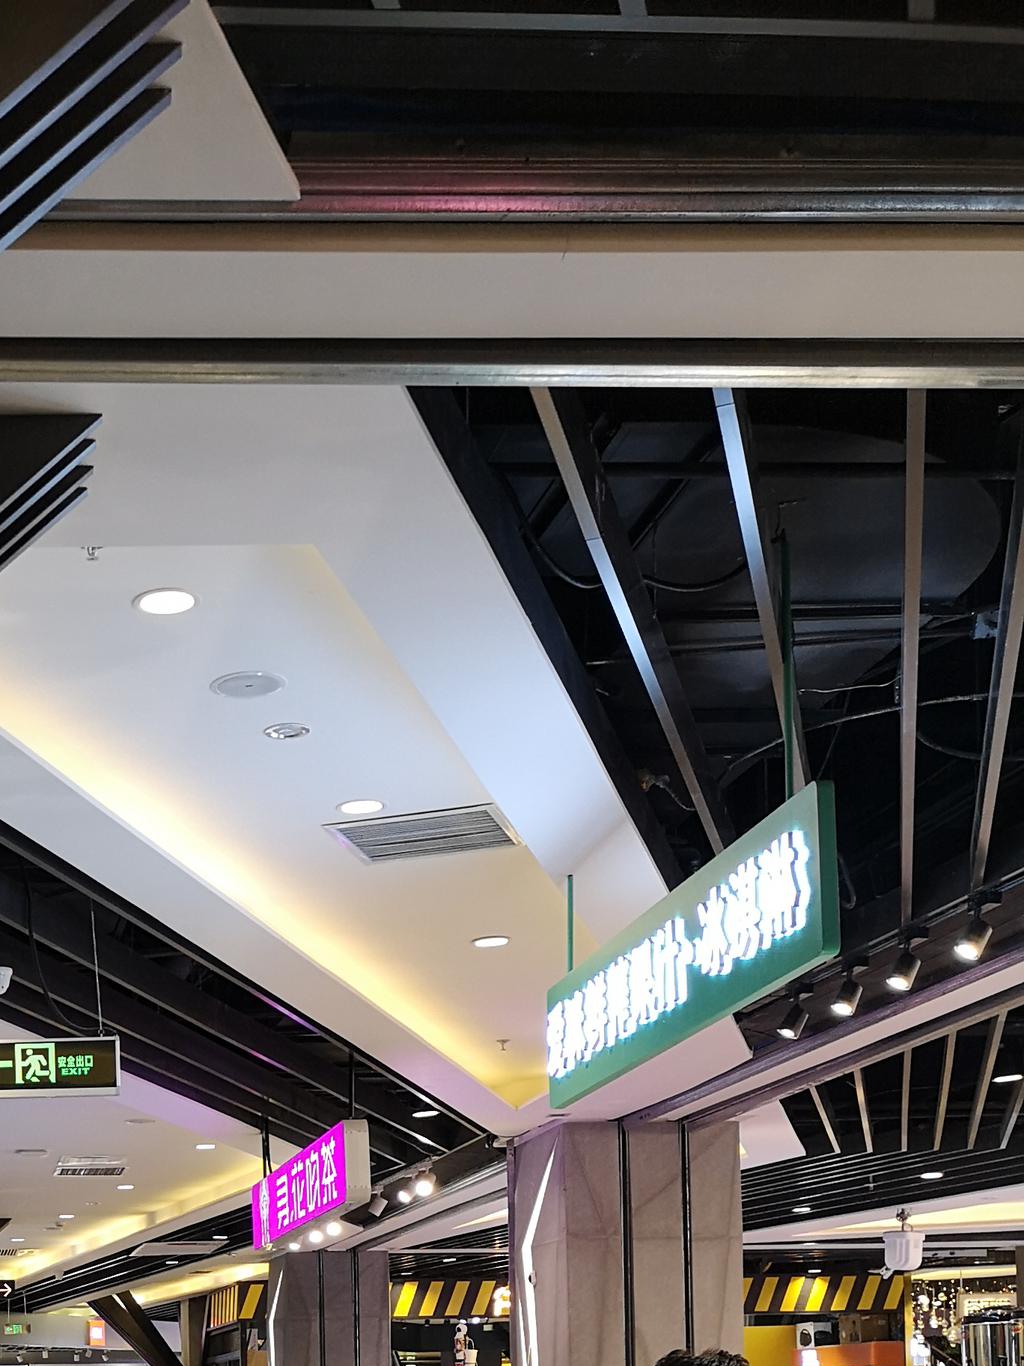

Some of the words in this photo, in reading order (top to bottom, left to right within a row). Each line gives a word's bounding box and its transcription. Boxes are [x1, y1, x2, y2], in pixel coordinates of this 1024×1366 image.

[57, 1055, 93, 1068] 安全出口
[61, 1067, 91, 1076] EXIT
